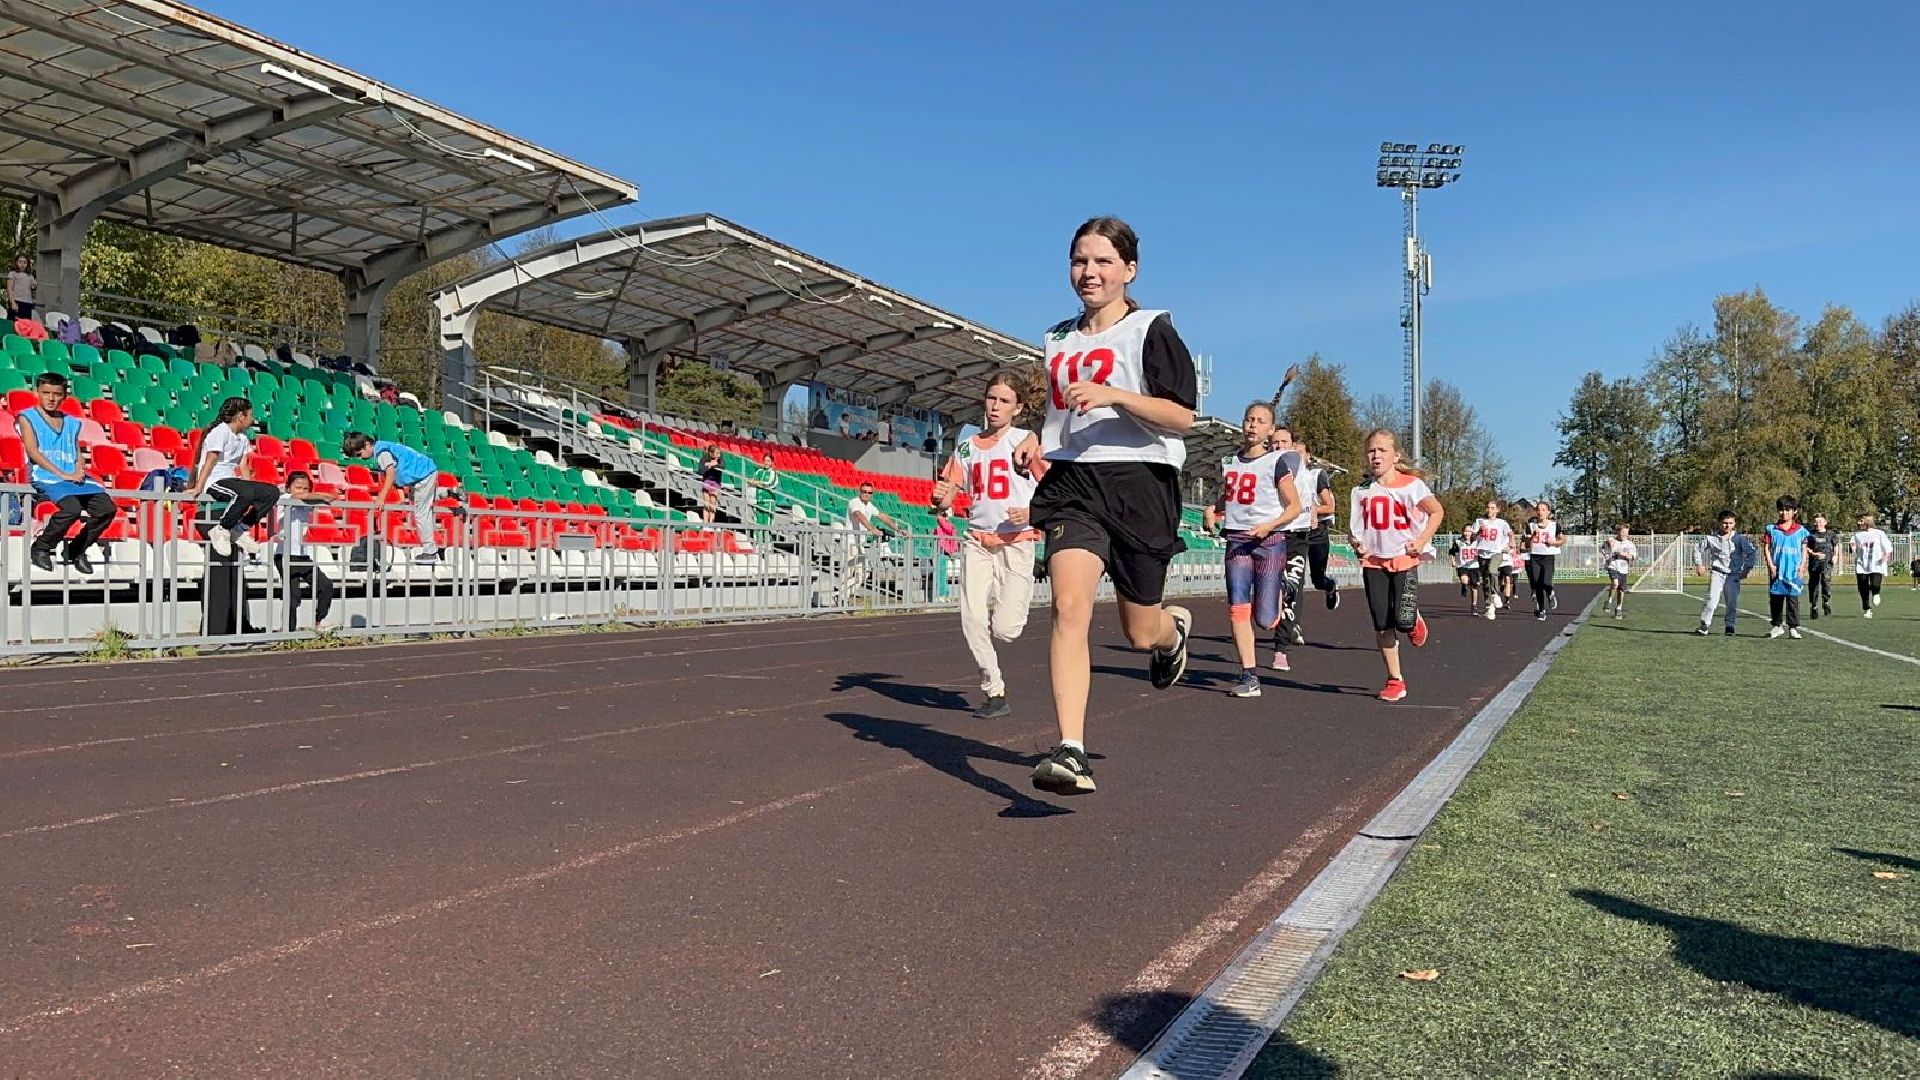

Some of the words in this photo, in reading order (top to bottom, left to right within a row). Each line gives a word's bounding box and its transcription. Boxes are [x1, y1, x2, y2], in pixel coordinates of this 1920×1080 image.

[1050, 348, 1114, 410] 112
[973, 459, 1010, 500] 46
[1360, 496, 1411, 530] 109
[1480, 526, 1498, 541] 48
